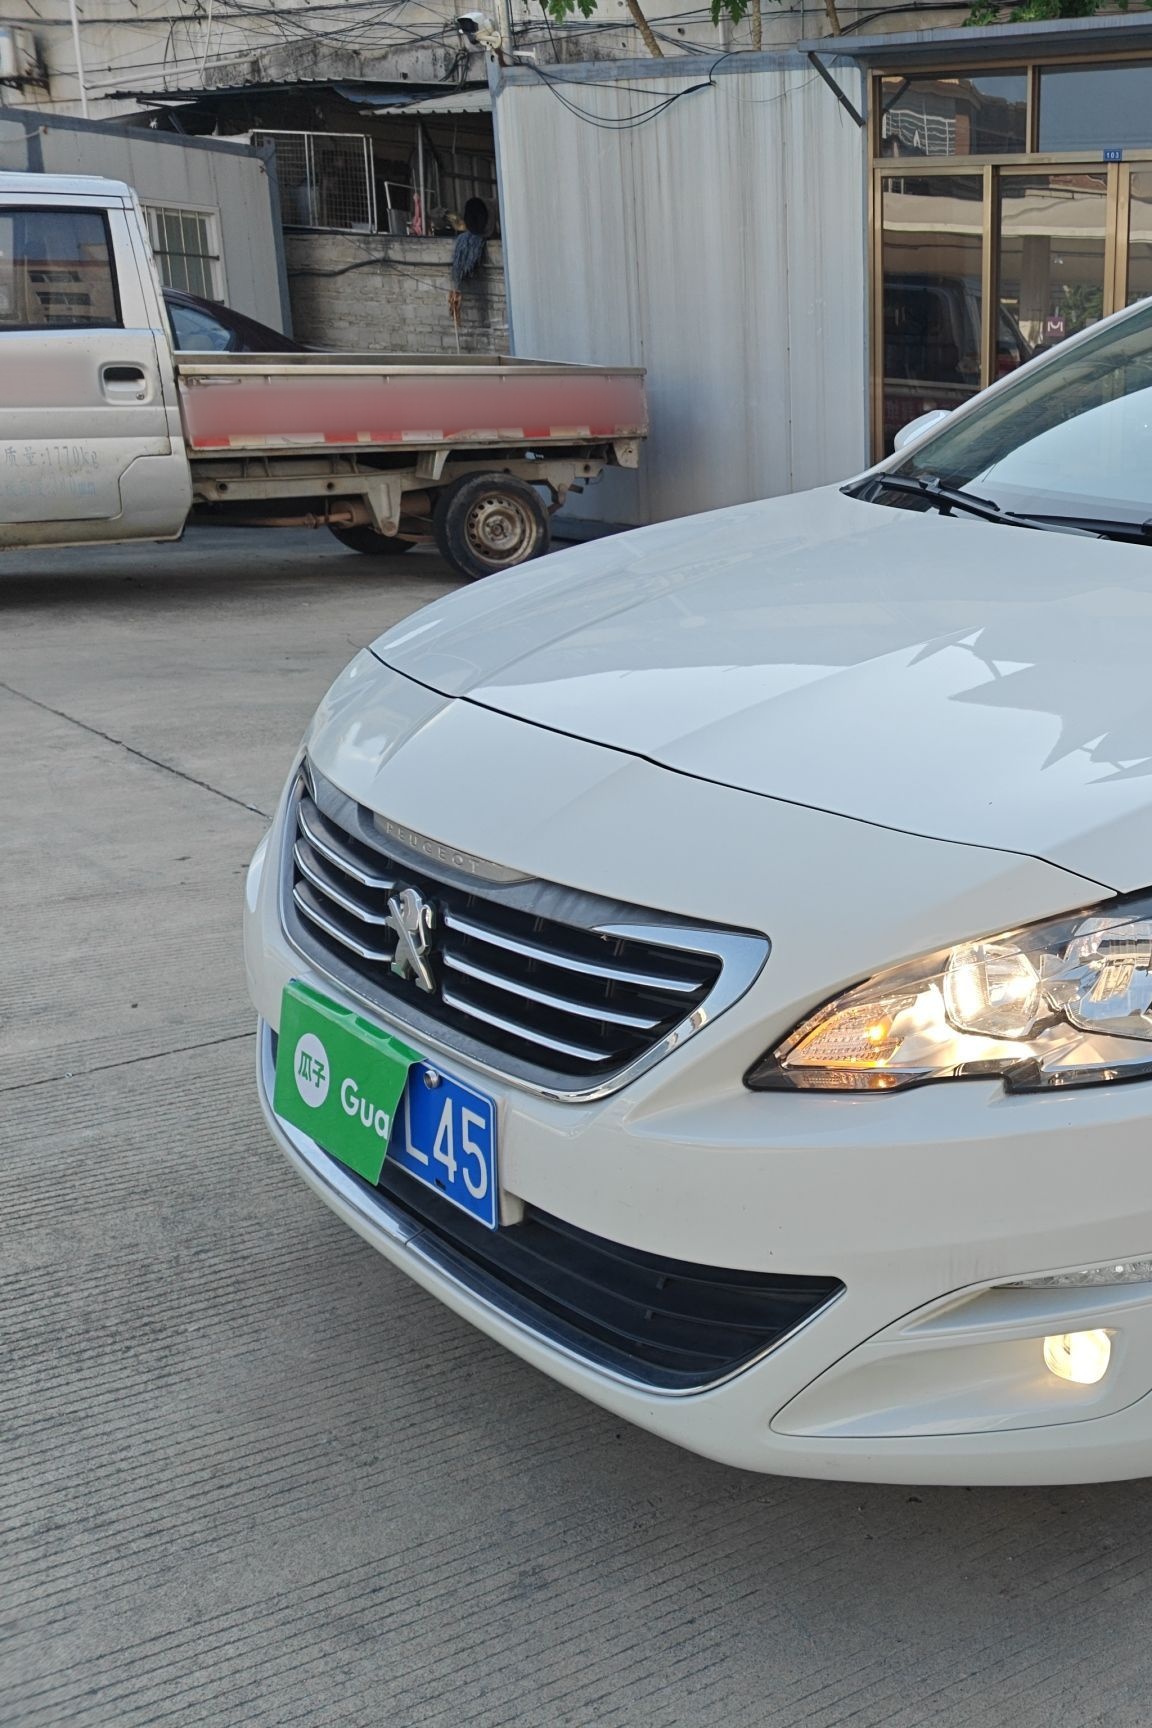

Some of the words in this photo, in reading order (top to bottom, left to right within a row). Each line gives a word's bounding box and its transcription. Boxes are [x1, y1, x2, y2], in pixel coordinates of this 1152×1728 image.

[1106, 151, 1120, 159] 103
[386, 822, 479, 874] PEUGEOT
[298, 1051, 326, 1088] 瓜子
[341, 1078, 389, 1140] Gua
